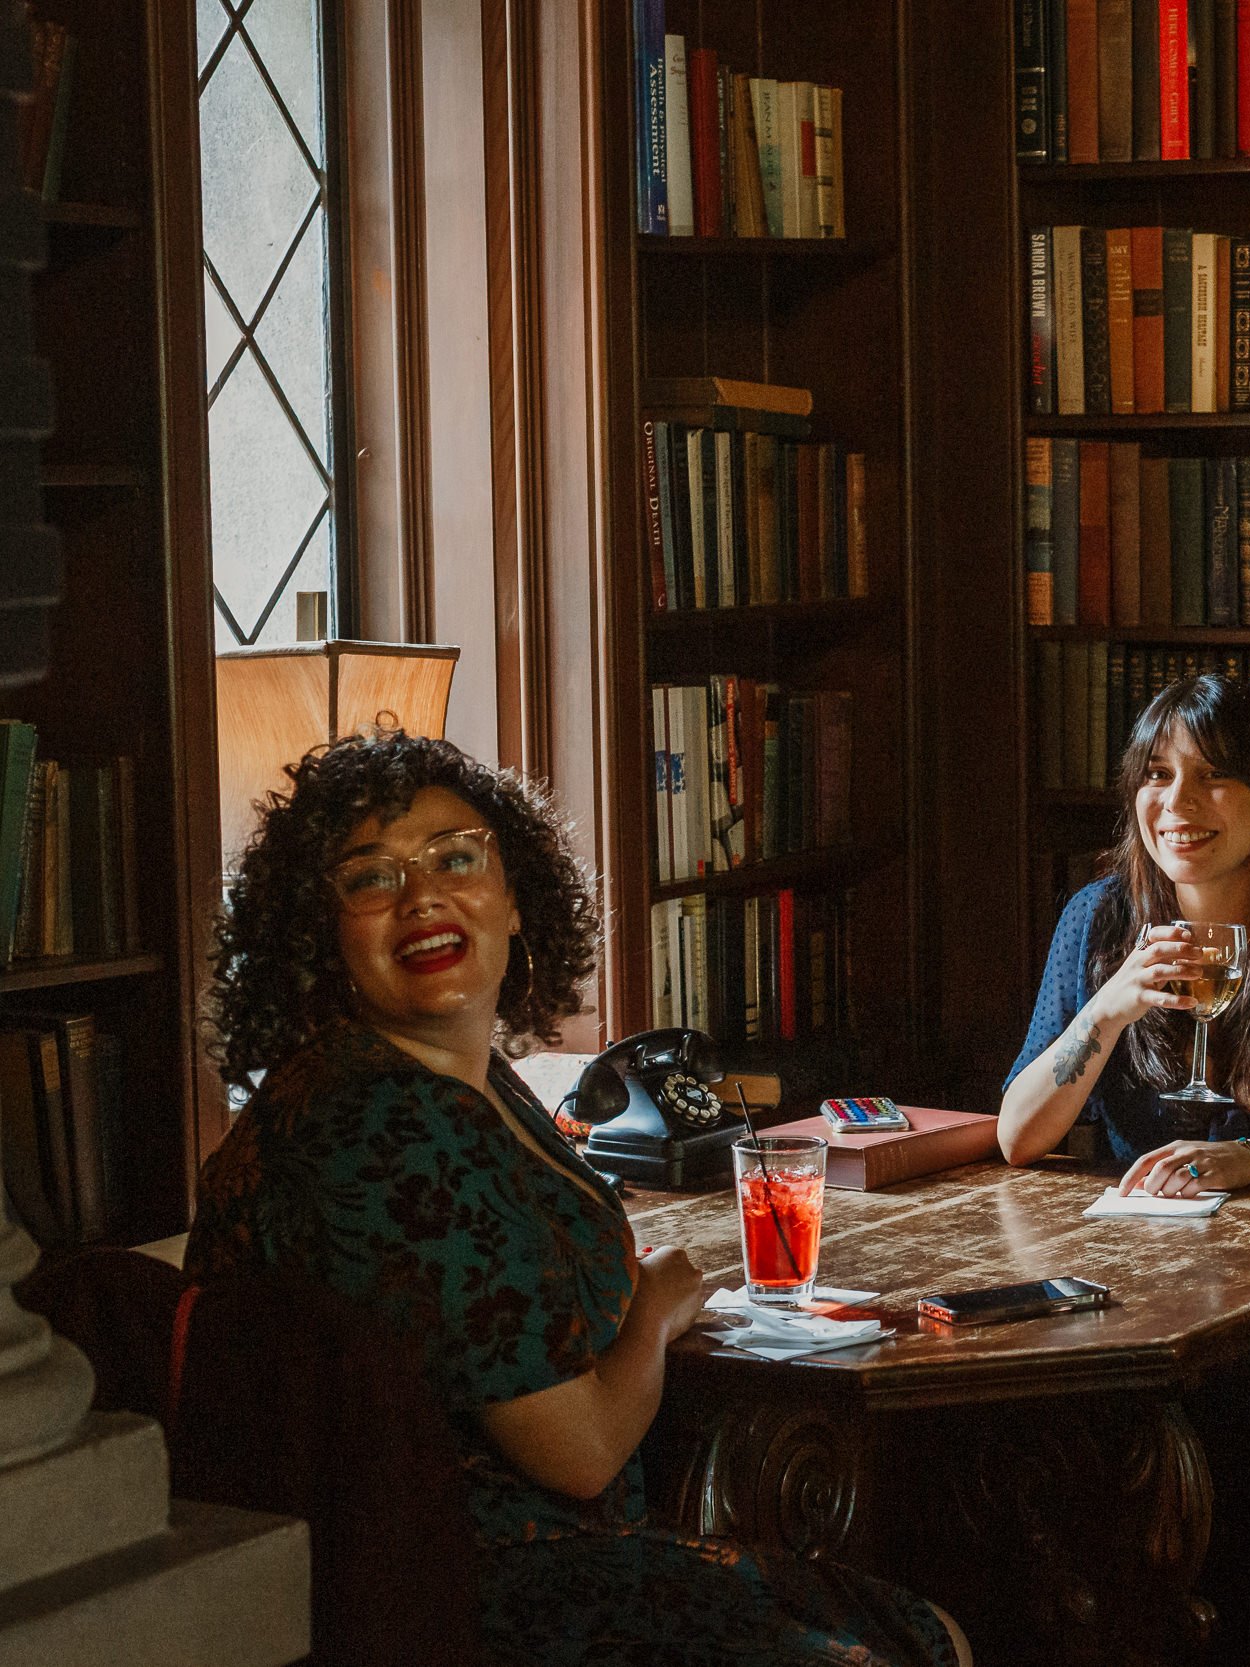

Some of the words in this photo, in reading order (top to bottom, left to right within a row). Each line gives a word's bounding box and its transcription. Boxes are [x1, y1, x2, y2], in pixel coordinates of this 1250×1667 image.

[657, 58, 666, 106] Health
[649, 63, 661, 176] Assessment
[658, 110, 666, 120] &
[659, 125, 667, 183] Physical
[1031, 234, 1046, 276] SANDRA
[1031, 279, 1046, 317] BROWN
[643, 421, 658, 492] ORIGINAL
[649, 498, 661, 546] DEATH
[729, 756, 737, 801] MARKET
